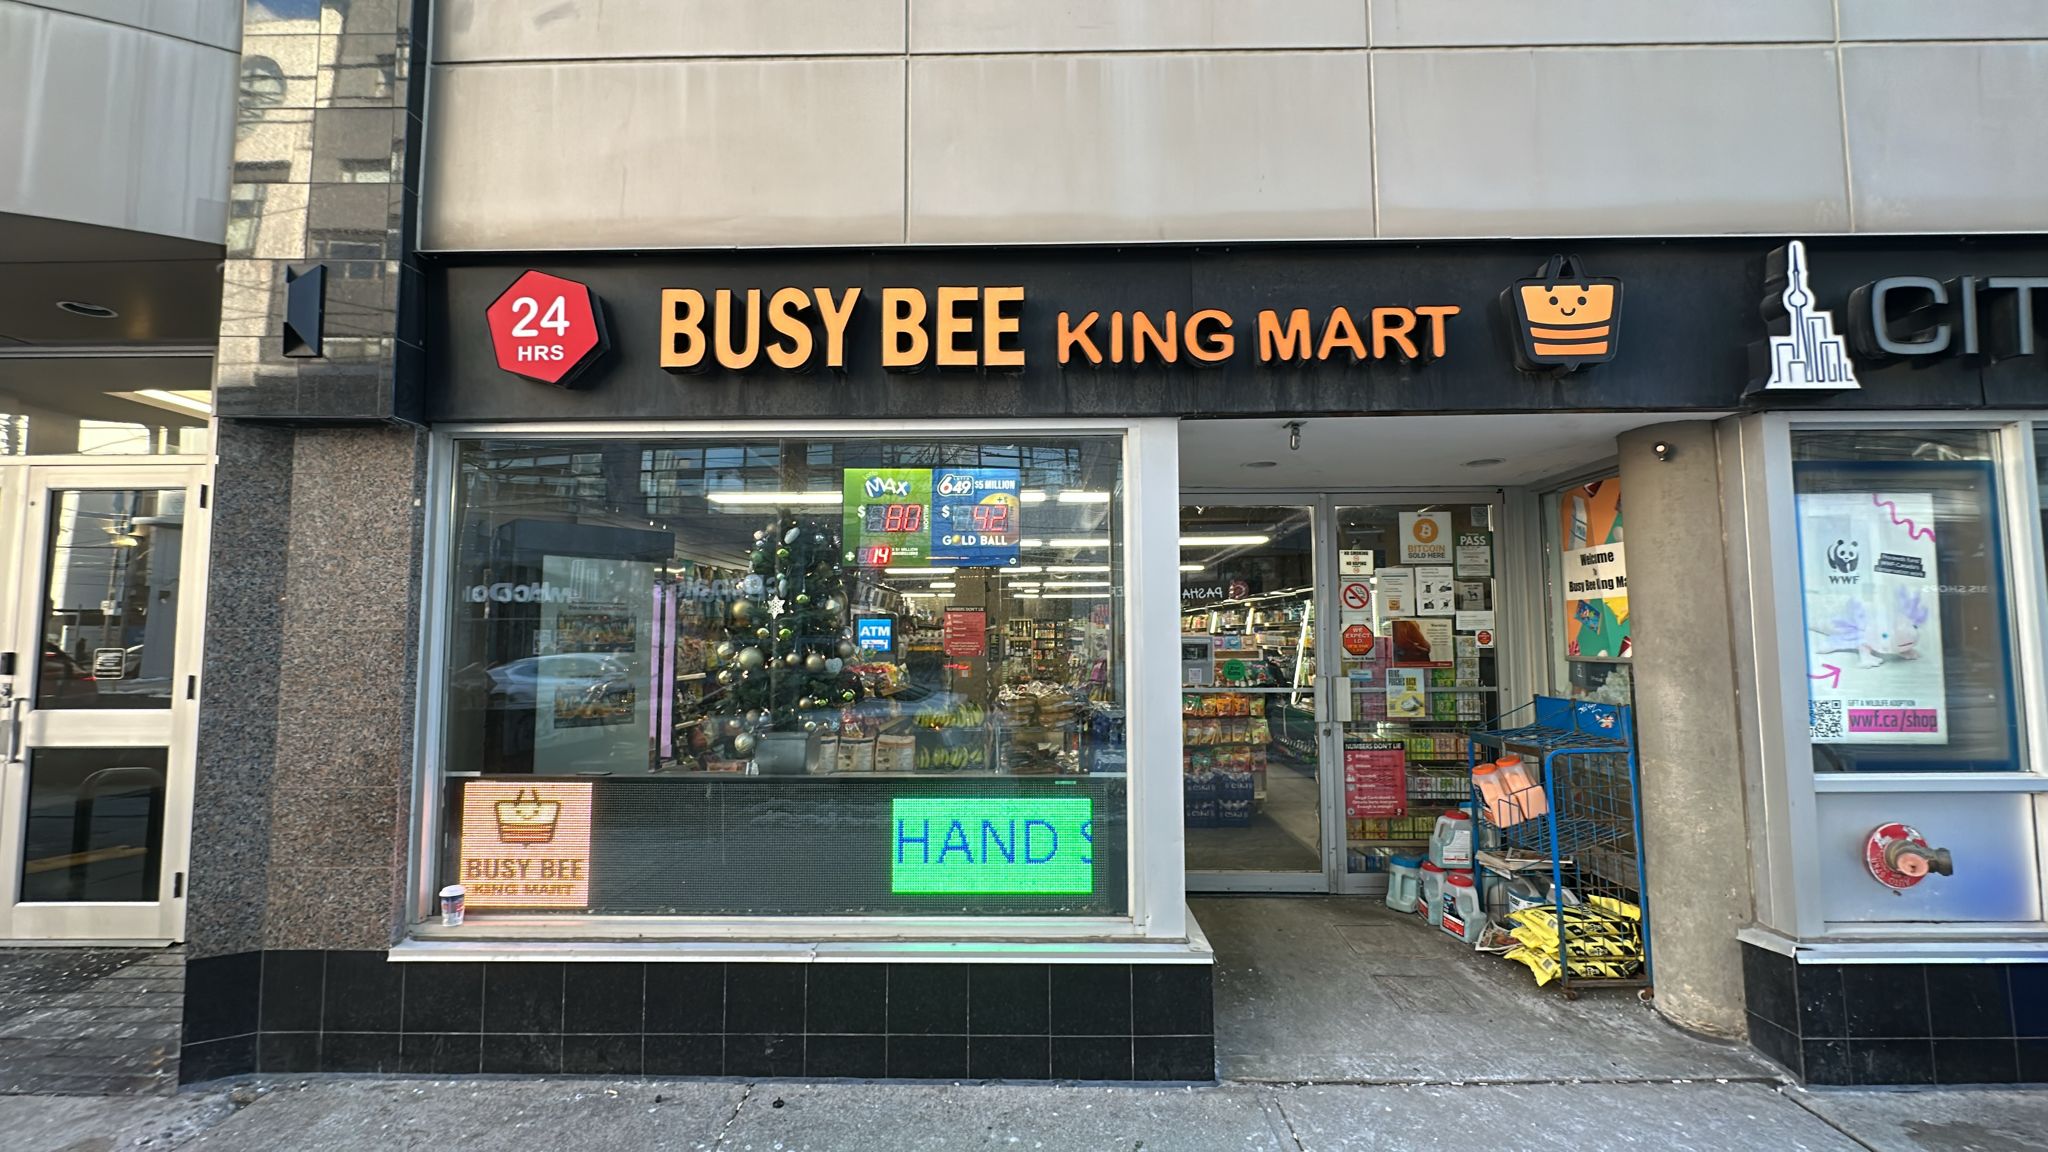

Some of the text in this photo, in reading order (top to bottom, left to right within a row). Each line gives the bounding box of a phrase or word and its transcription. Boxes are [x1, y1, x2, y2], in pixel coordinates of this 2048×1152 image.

[511, 295, 571, 338] 24
[660, 286, 1025, 369] BUSY BEE
[1057, 305, 1462, 364] KING MART
[517, 345, 565, 362] HRS
[865, 477, 909, 498] MAX
[984, 480, 1016, 490] MILLION
[885, 504, 922, 531] 80
[974, 504, 1007, 531] 42
[980, 535, 1008, 546] BALL
[1407, 544, 1446, 553] BITCOIN
[1460, 535, 1487, 546] PASS
[1580, 551, 1615, 566] Welcome
[1568, 581, 1585, 592] Busy
[1585, 579, 1597, 591] Bee
[1828, 575, 1860, 585] WWF
[860, 626, 891, 637] ATM
[897, 818, 1059, 865] HAND
[466, 858, 586, 880] BUSY BEE
[474, 884, 576, 896] KING MART
